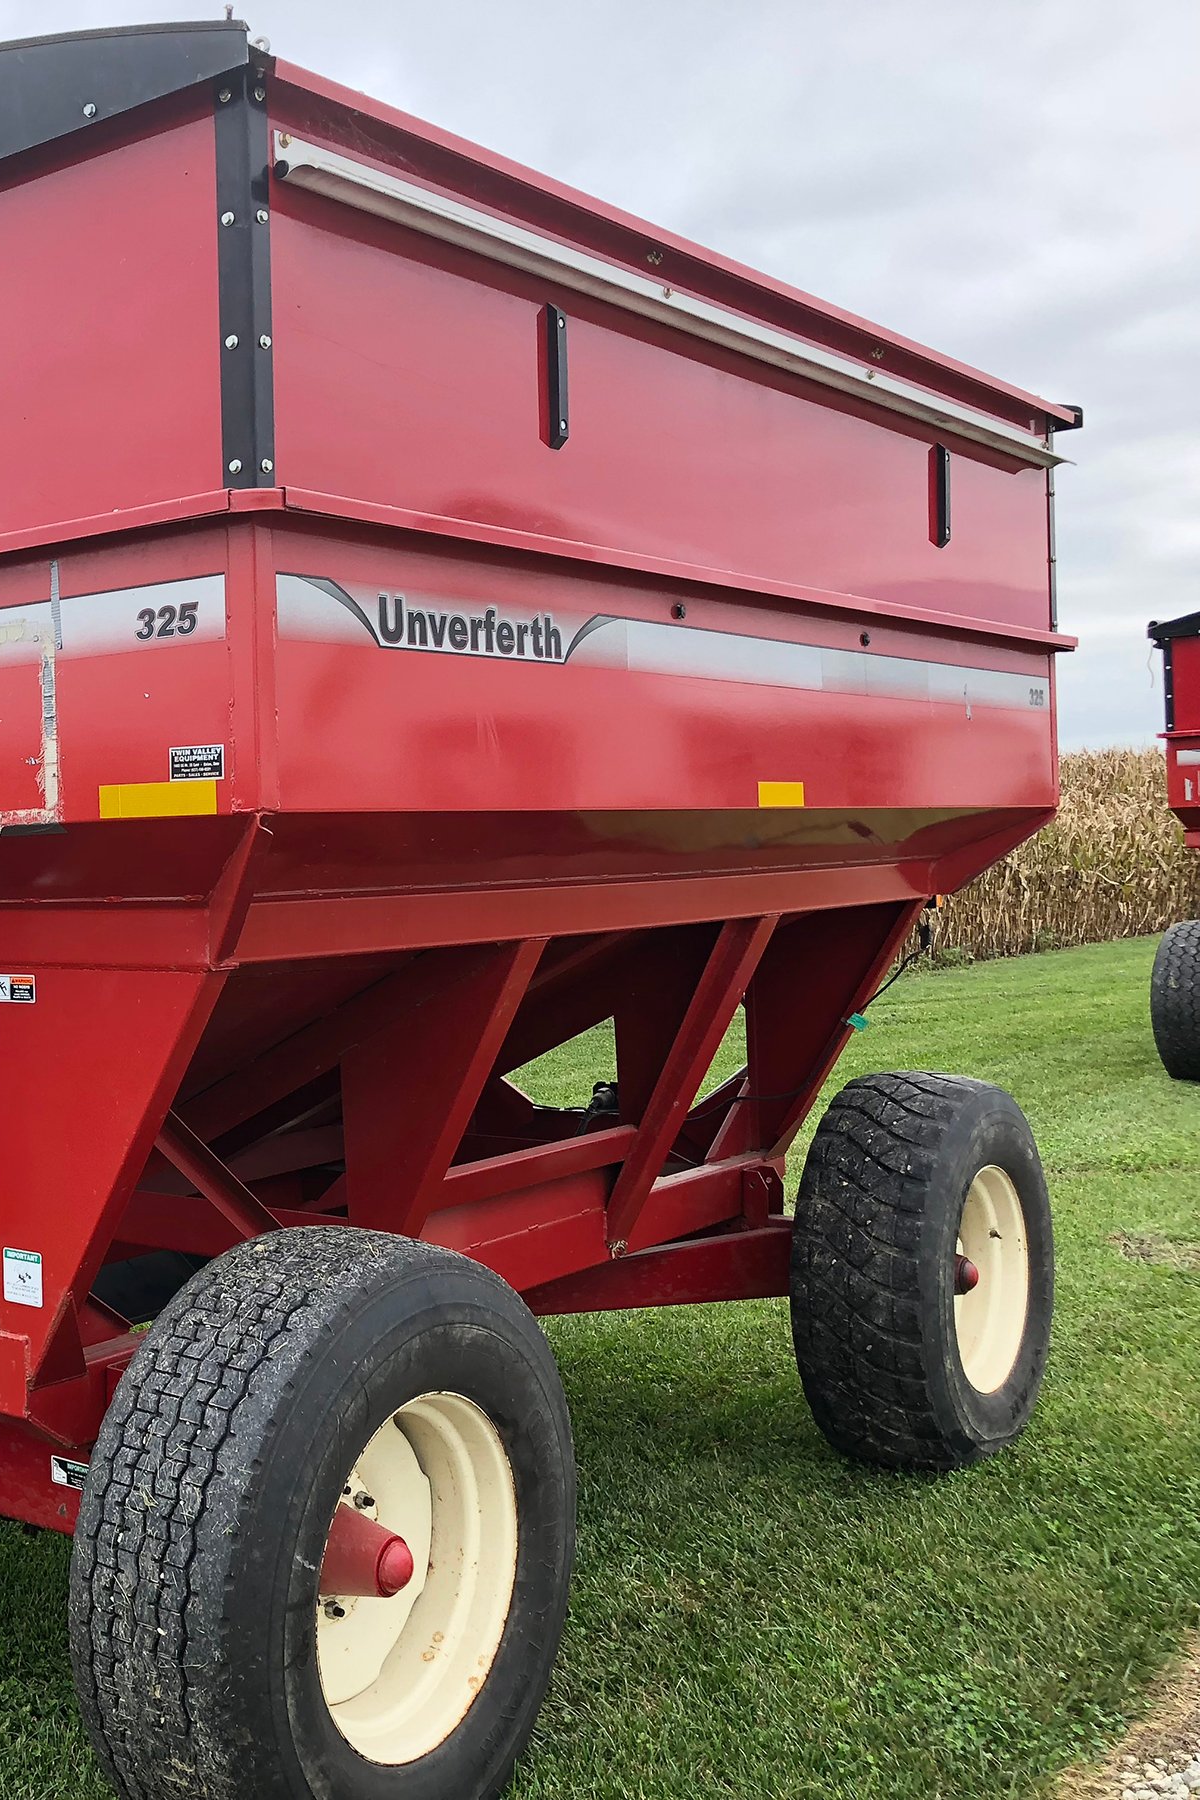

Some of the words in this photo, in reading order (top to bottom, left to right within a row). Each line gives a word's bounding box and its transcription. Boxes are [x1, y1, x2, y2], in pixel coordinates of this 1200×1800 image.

[135, 601, 200, 641] 325
[378, 594, 562, 660] Unverferth
[1029, 688, 1044, 706] 325
[174, 754, 219, 762] EQUIPMENT
[192, 747, 221, 755] VALLEY
[6, 1251, 38, 1261] IMPORTANT
